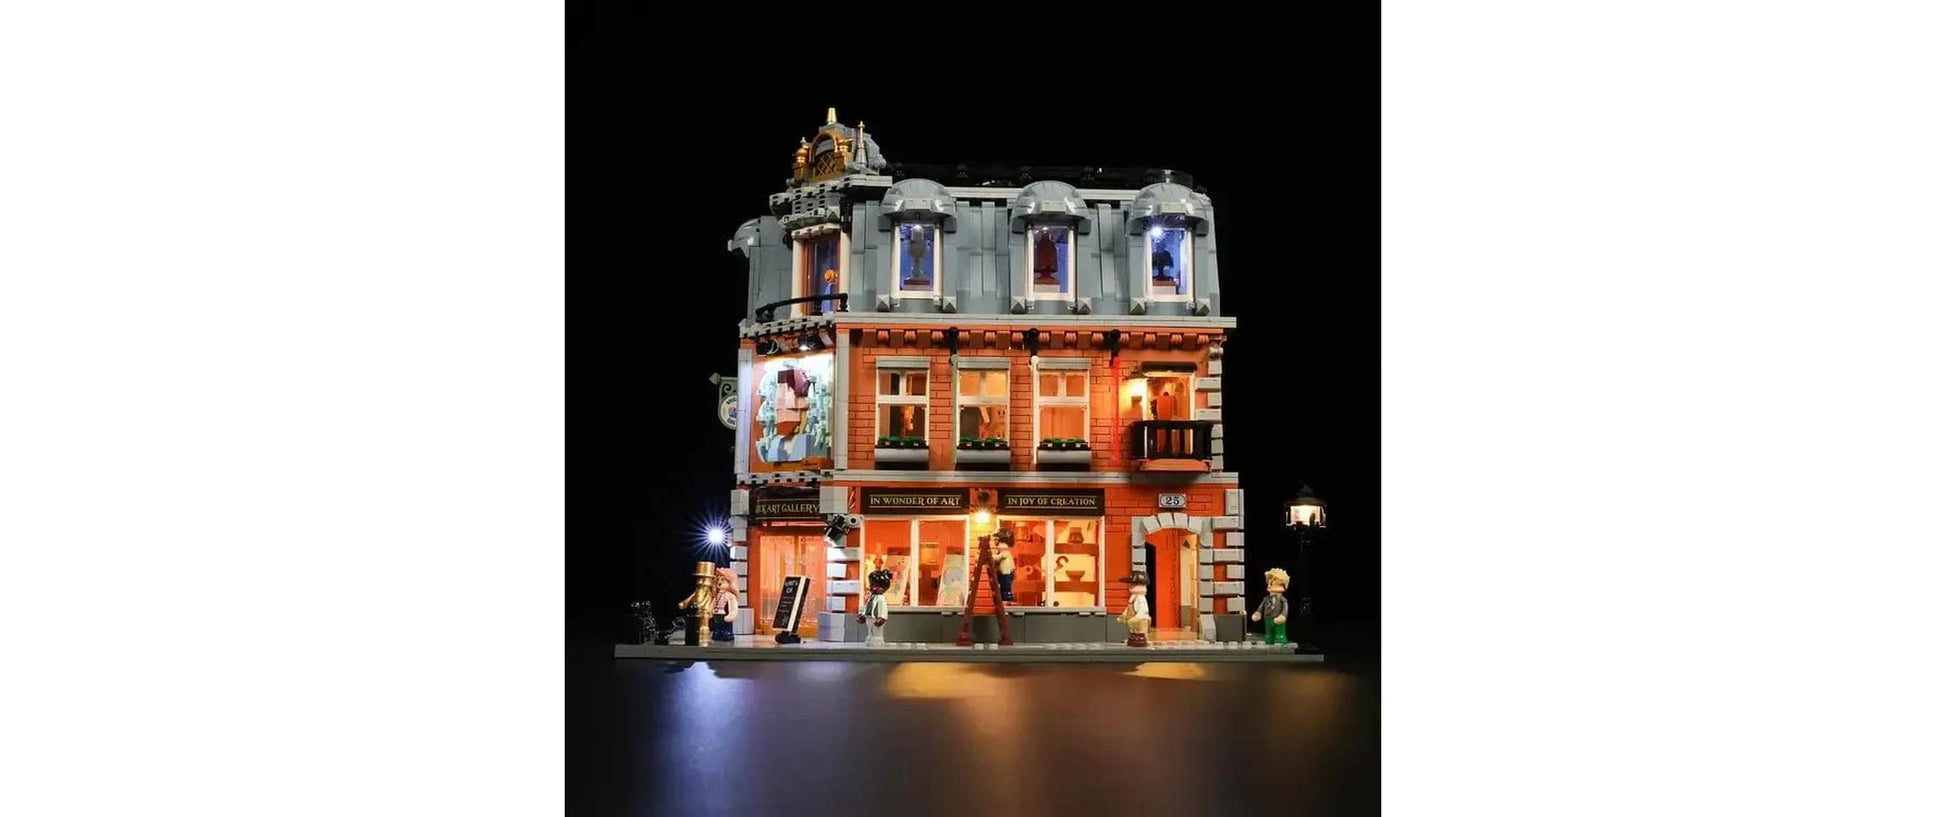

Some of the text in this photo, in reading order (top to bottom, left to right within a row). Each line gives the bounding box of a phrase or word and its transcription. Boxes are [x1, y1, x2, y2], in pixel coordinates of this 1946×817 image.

[870, 496, 960, 506] IN WONDER OF ART
[1007, 497, 1096, 506] IN JOY OF CREATION
[1165, 496, 1180, 505] 25
[767, 504, 780, 513] ART
[781, 503, 818, 513] GALLERY
